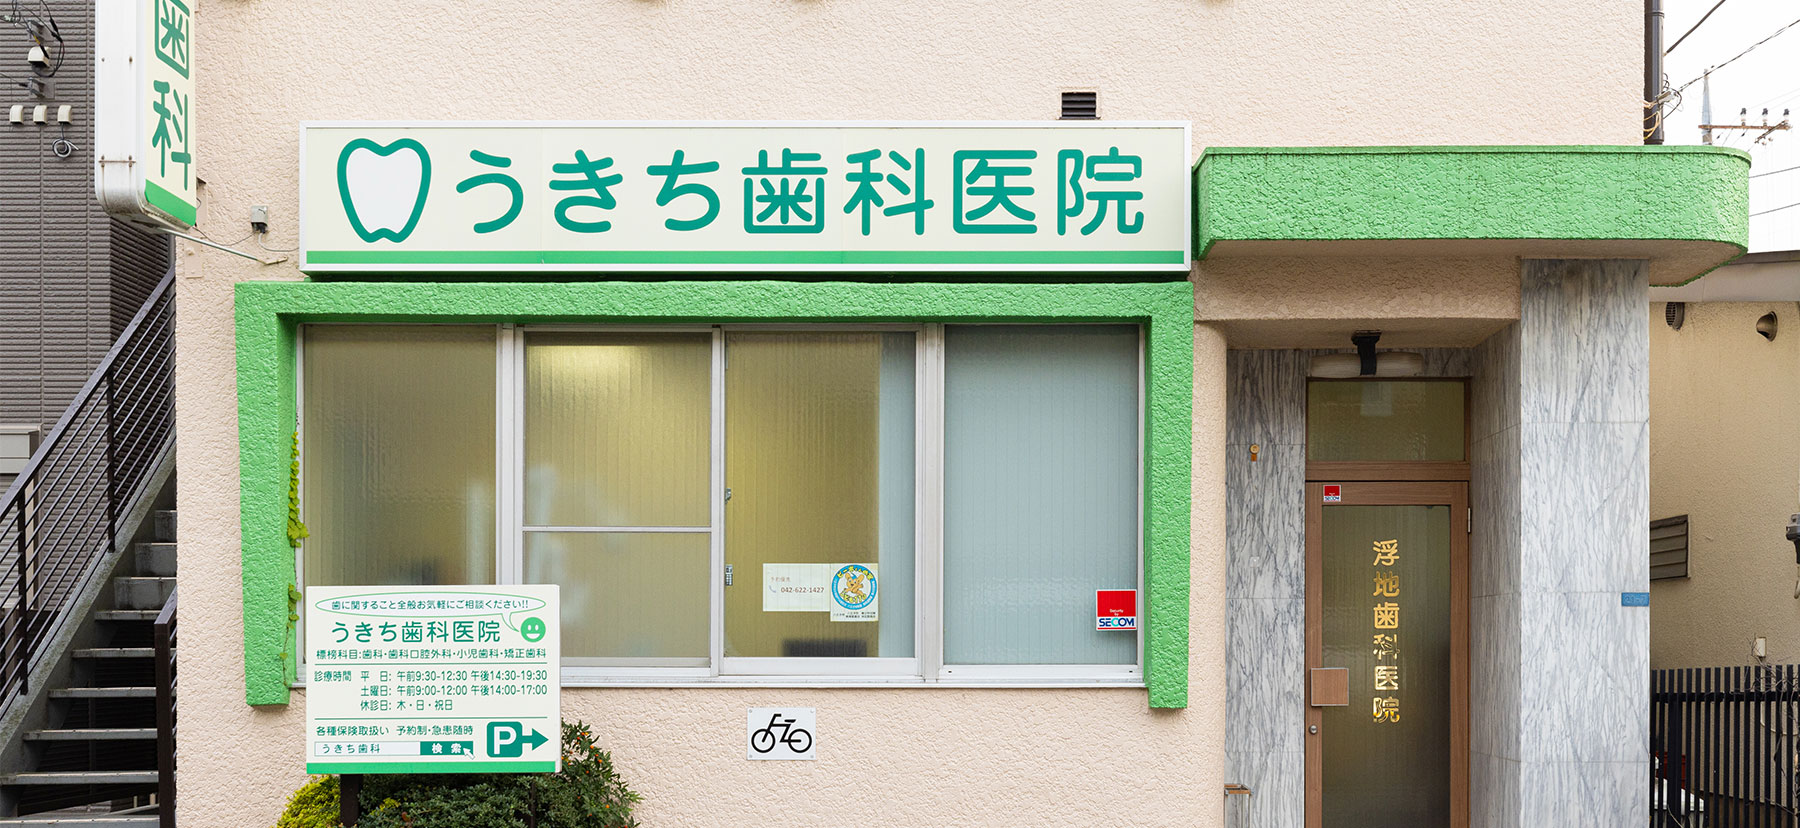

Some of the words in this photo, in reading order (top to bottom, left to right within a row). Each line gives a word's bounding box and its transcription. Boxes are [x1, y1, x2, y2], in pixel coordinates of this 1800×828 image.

[456, 147, 1144, 236] うきち歯科医院
[1098, 617, 1135, 627] SECOM
[331, 620, 501, 643] うきち歯科医院
[1372, 539, 1400, 723] 浮地歯科医院
[314, 670, 352, 683] 診療時間
[396, 670, 468, 682] 午前9:30-12:30
[470, 669, 548, 682] 午後14:30-19:30
[360, 685, 392, 697] 土曜日:
[396, 685, 468, 697] 午前9:00-12:00
[470, 684, 548, 697] 午後14:00-17:00
[360, 700, 392, 711] 休診日:
[316, 725, 390, 737] 各種保険取扱い
[322, 743, 381, 754] うきち歯科
